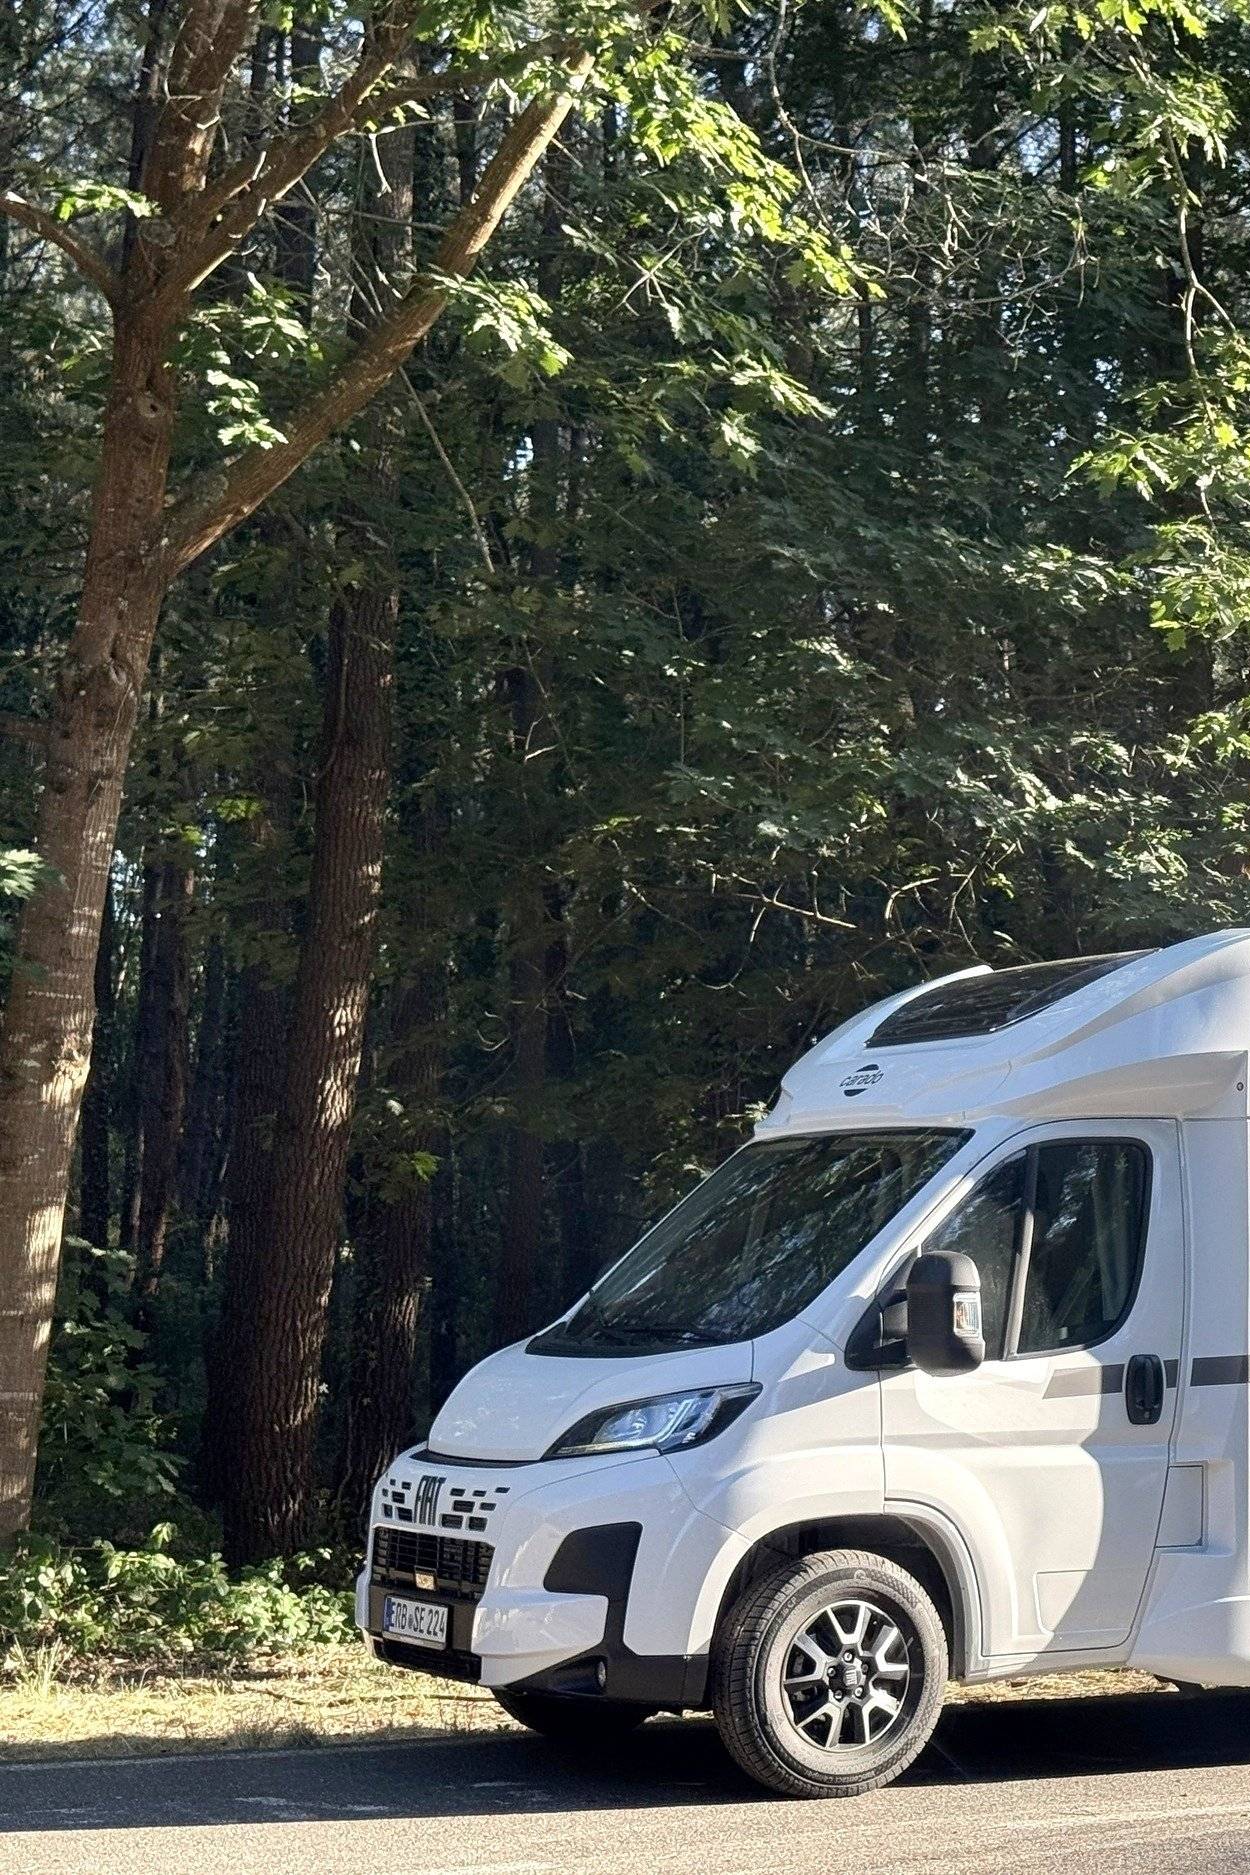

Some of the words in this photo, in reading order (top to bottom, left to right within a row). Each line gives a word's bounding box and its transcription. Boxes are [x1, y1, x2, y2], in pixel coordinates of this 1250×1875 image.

[839, 1070, 884, 1087] carado
[413, 1475, 447, 1526] FIAT
[390, 1602, 407, 1630] ERB
[413, 1605, 426, 1634] SE
[426, 1608, 445, 1637] 224
